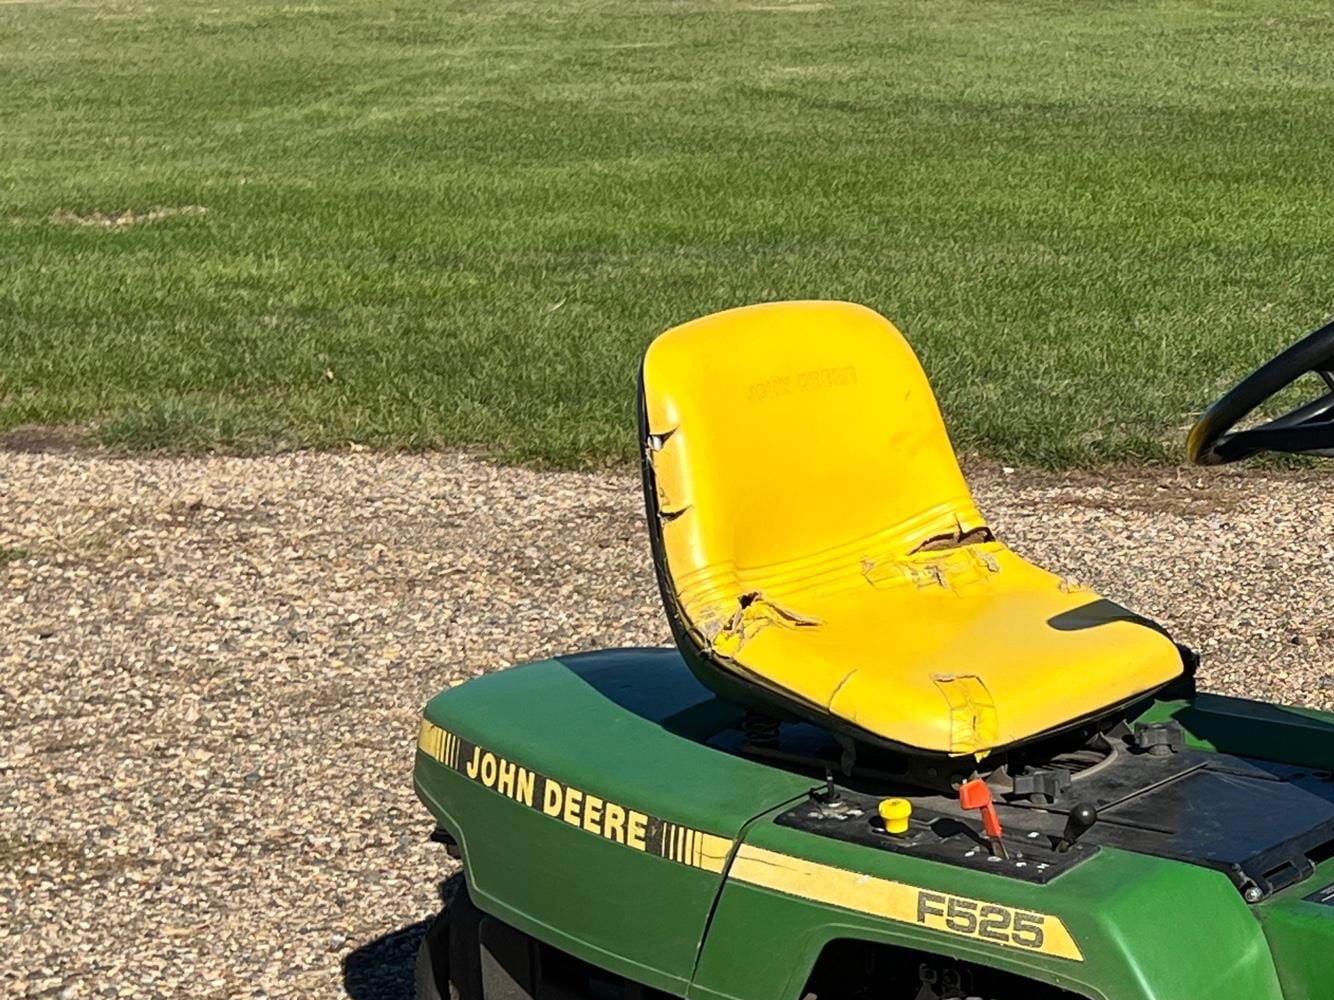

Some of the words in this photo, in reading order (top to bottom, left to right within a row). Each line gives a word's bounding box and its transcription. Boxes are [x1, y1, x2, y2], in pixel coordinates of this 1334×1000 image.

[466, 746, 535, 807] JOHN
[543, 778, 648, 851] DEERE
[917, 890, 1045, 949] F525
